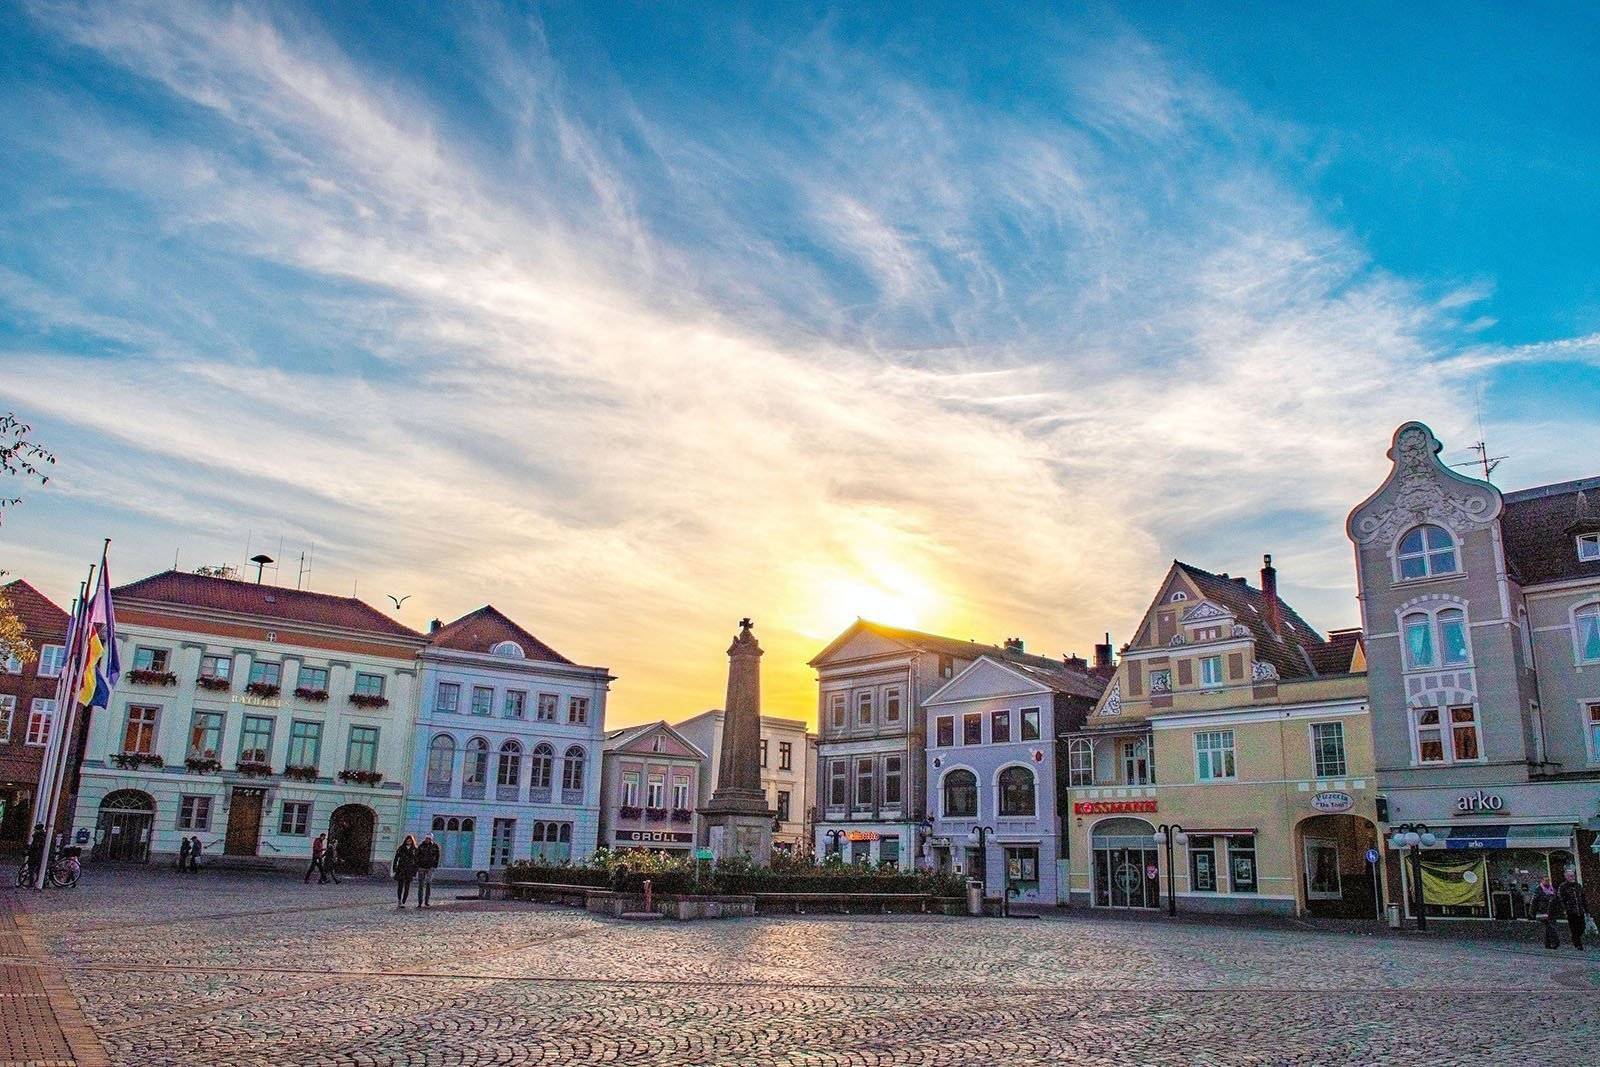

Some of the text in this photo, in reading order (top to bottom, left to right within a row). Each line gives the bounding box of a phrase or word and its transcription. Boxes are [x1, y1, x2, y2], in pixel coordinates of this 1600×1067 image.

[1315, 793, 1349, 801] Pizzeria
[1458, 790, 1503, 810] arko
[1074, 801, 1157, 815] ROSSMANN
[631, 831, 678, 842] GRÖLL
